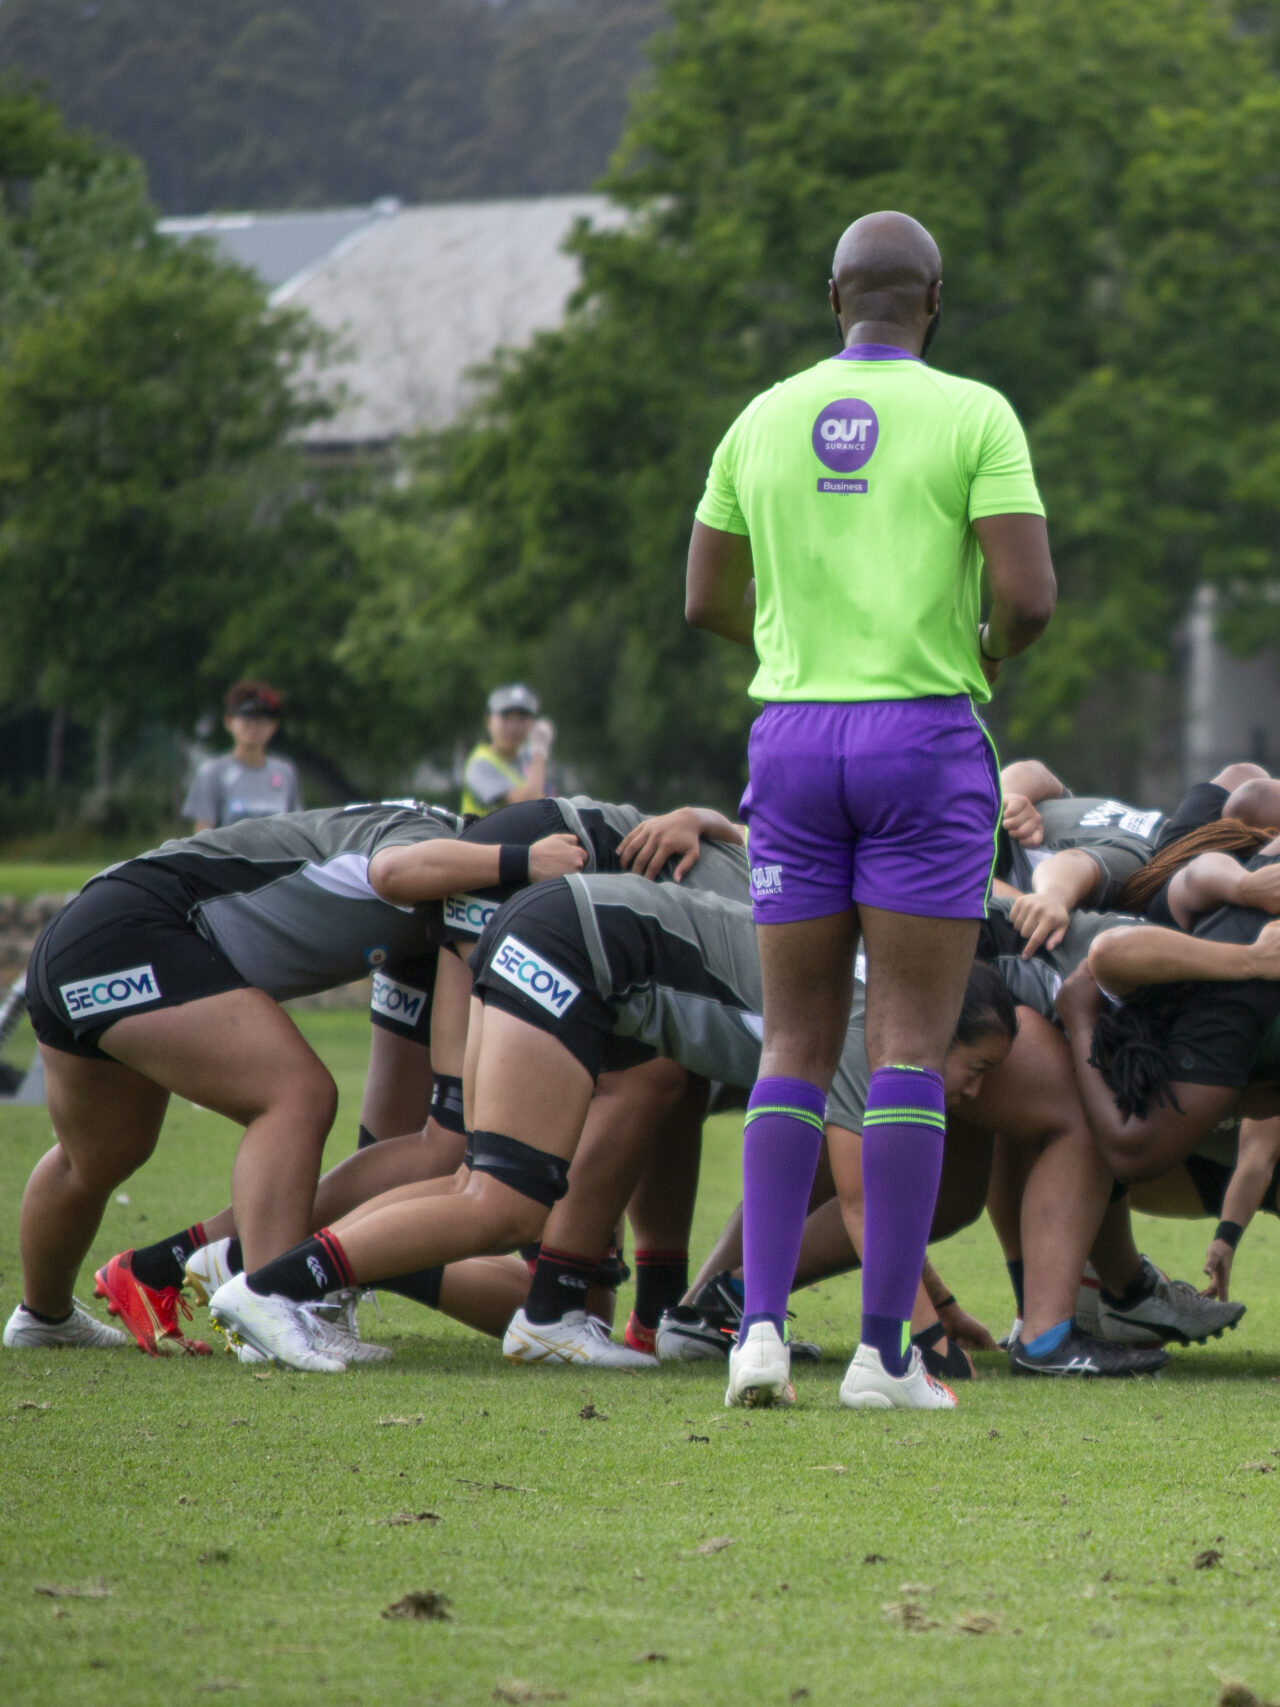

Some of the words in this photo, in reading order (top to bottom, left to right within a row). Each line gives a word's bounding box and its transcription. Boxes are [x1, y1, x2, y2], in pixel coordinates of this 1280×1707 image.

[820, 419, 872, 442] OUT
[825, 443, 865, 451] SURANCE
[823, 481, 863, 491] Business
[751, 865, 782, 888] OUT
[446, 896, 496, 926] SECO
[495, 944, 573, 1009] SECOM
[65, 973, 153, 1012] SECOM
[372, 979, 421, 1018] ECOM
